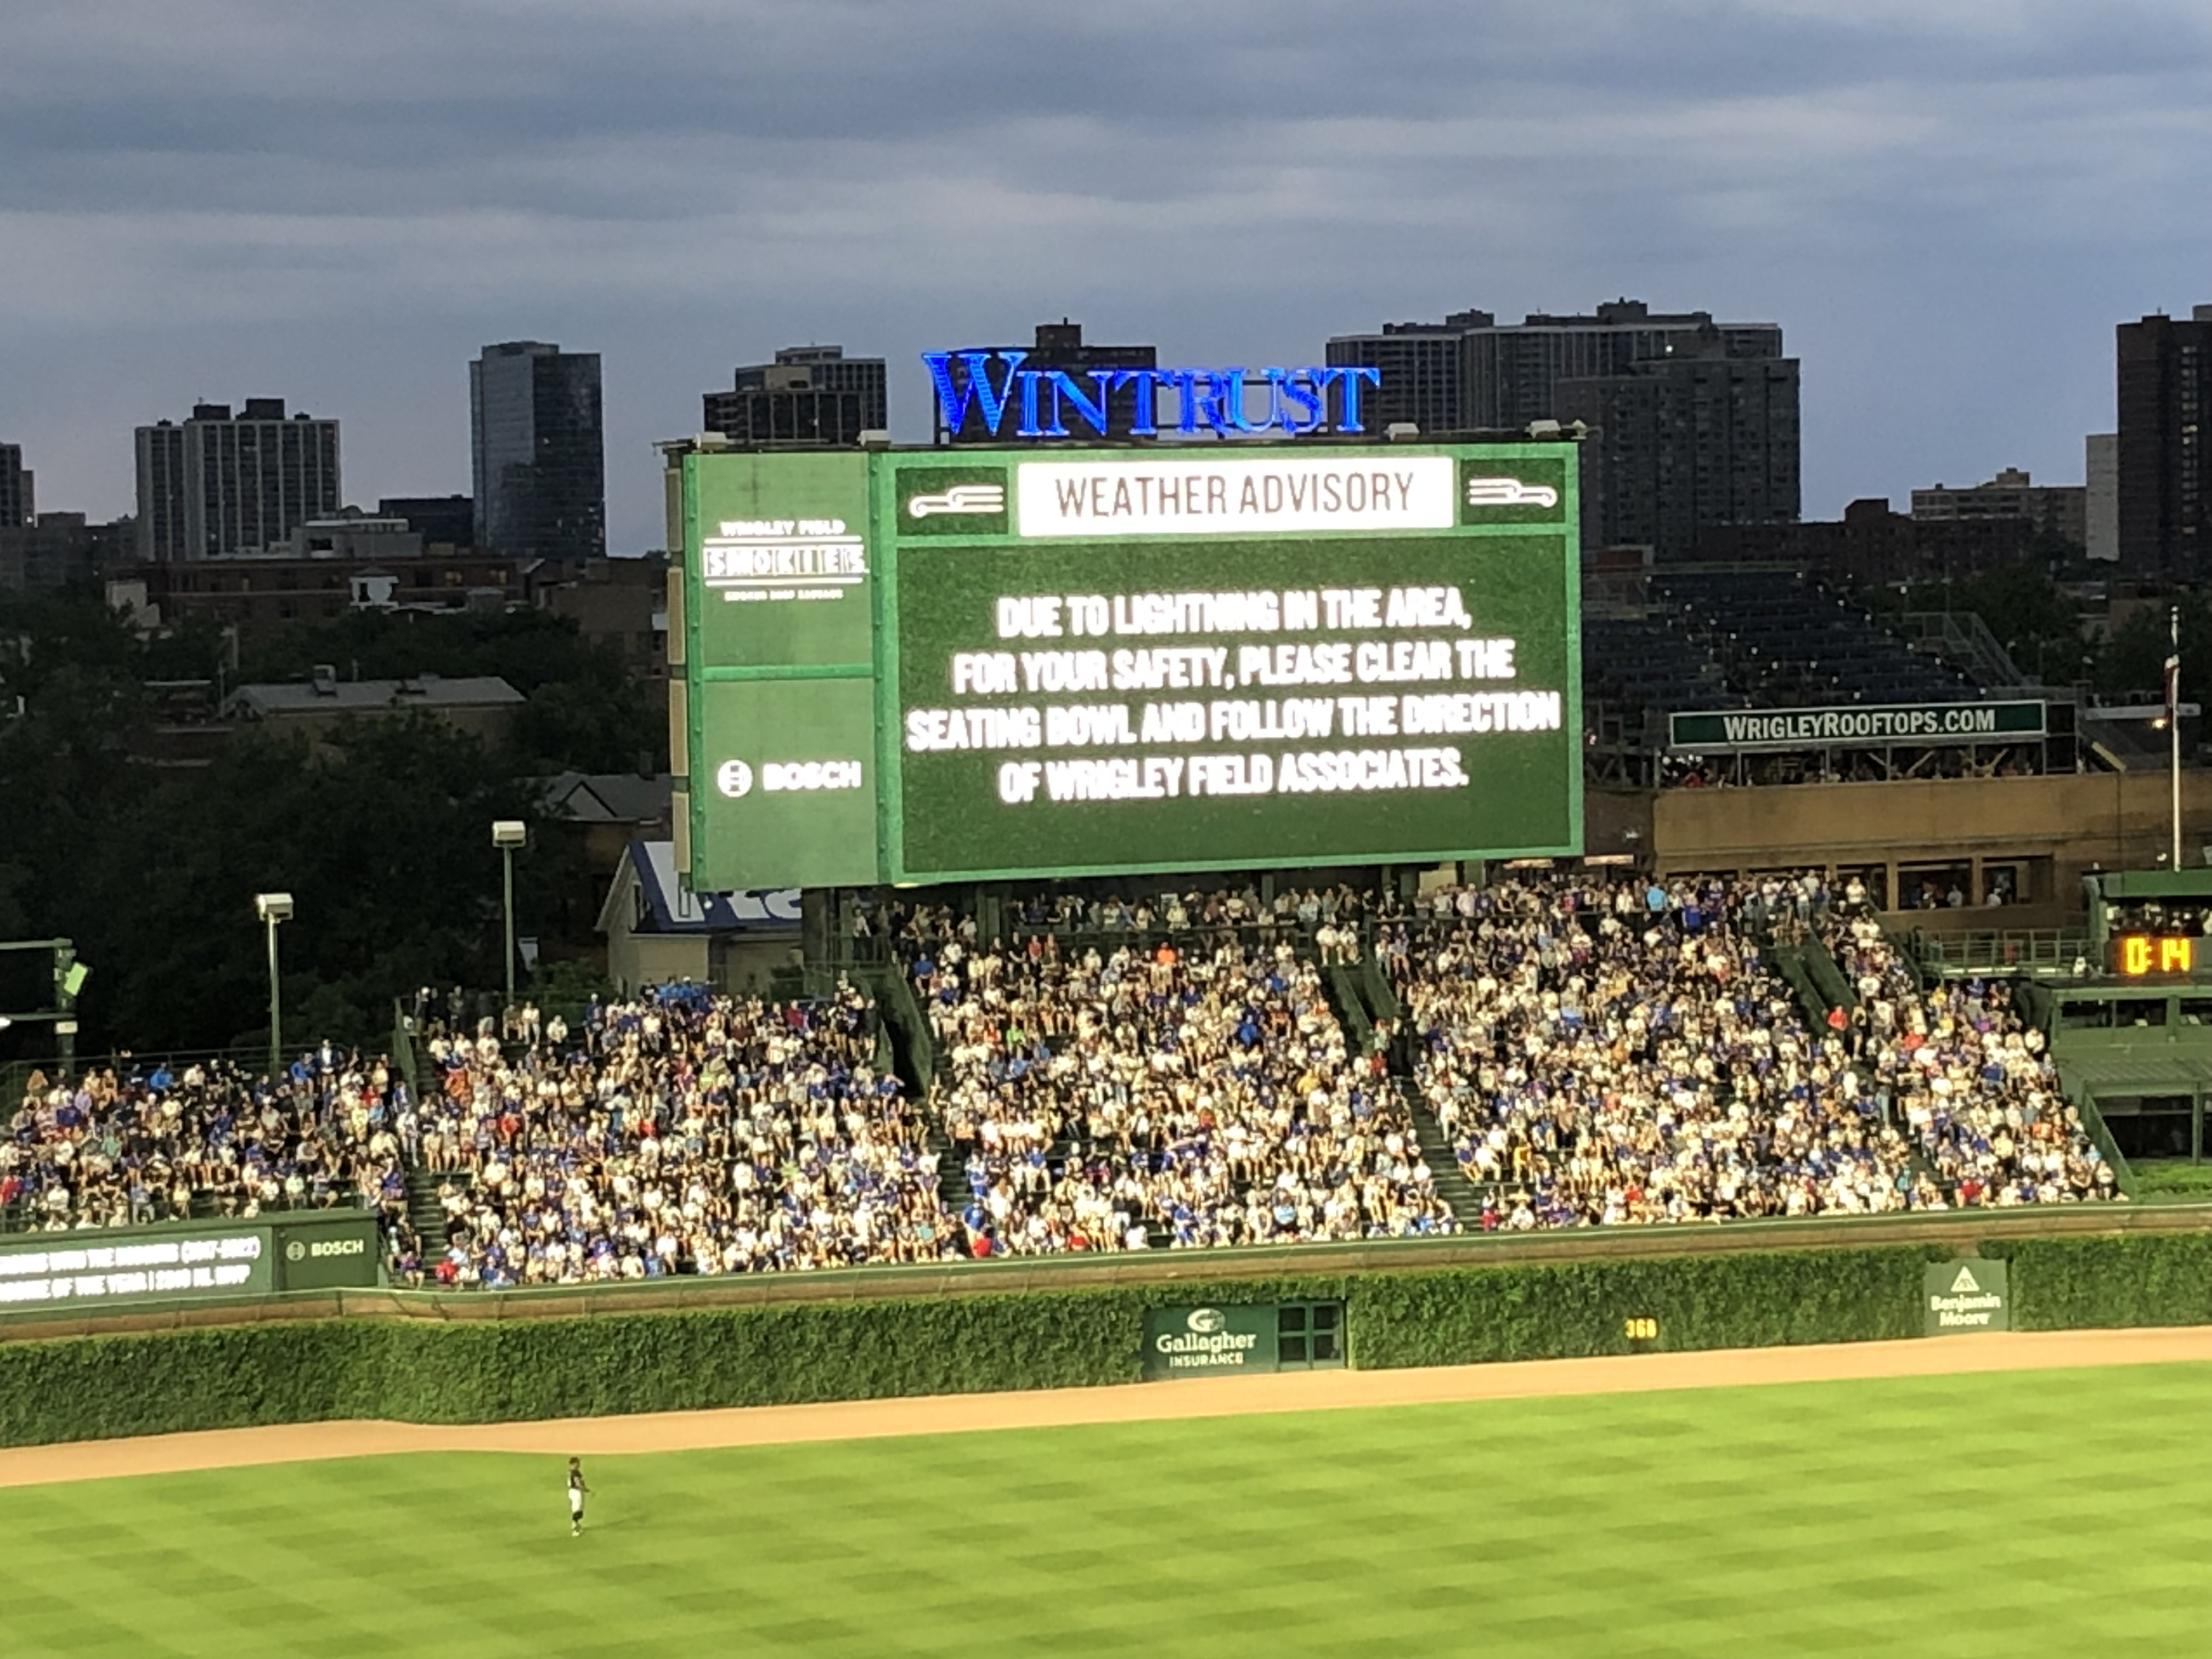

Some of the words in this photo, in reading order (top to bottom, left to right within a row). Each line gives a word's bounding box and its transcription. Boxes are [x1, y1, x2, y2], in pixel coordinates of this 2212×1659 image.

[922, 351, 1380, 437] WINTRUST
[1056, 476, 1226, 517] WEATHER
[1239, 472, 1413, 514] ADVISORY
[997, 596, 1063, 637] DUE
[1065, 595, 1109, 636] TO
[1114, 590, 1279, 634] LIGHTNING
[1283, 590, 1318, 630] IN
[1321, 589, 1383, 629] THE
[1385, 587, 1471, 629] AREA,
[953, 652, 1018, 693] FOR
[1020, 650, 1108, 692] YOUR
[1112, 647, 1234, 690] SAFETY,
[1239, 643, 1352, 685] PLEASE
[1356, 641, 1452, 682] CLEAR
[1455, 639, 1515, 679] THE
[907, 707, 1041, 751] SEATING
[1046, 704, 1137, 746] BOWL
[1141, 702, 1206, 743] AND
[1210, 698, 1335, 741] FOLLOW
[1337, 696, 1398, 736] THE
[1402, 691, 1560, 734] DIRECTION
[1723, 709, 1995, 740] WRIGLEYROOFTOPS.COM
[999, 761, 1042, 803] OF
[1045, 757, 1184, 800] WRIGLEY
[1188, 754, 1273, 795] FIELD
[1278, 747, 1469, 792] ASSOCIATES.
[311, 1239, 364, 1257] BOSCH
[1931, 1293, 2001, 1313] Benjamin
[1156, 1331, 1256, 1353] Gallagher
[1169, 1352, 1243, 1367] INSURANCE
